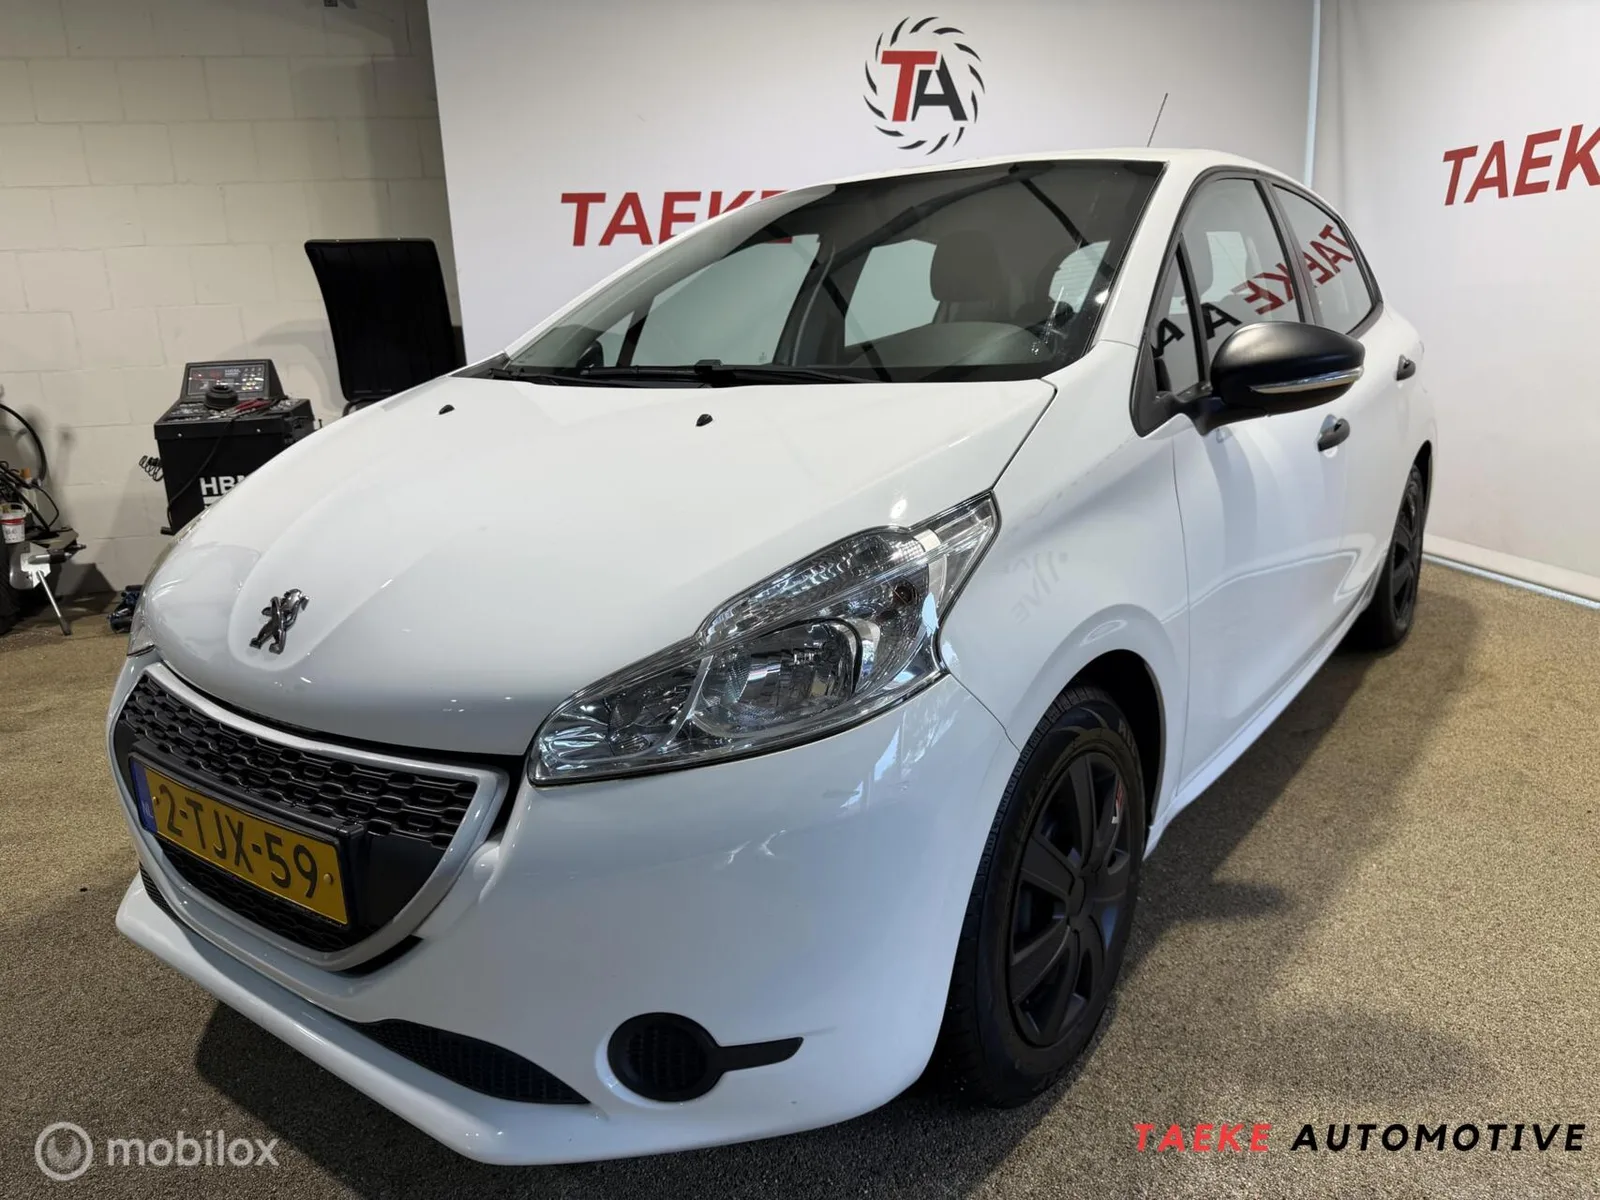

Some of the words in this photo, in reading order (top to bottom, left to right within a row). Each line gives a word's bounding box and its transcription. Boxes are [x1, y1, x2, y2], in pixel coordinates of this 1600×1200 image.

[881, 50, 968, 122] TA
[1443, 124, 1600, 206] TAEK
[200, 475, 246, 495] HB
[159, 784, 318, 899] 2-TJX-59
